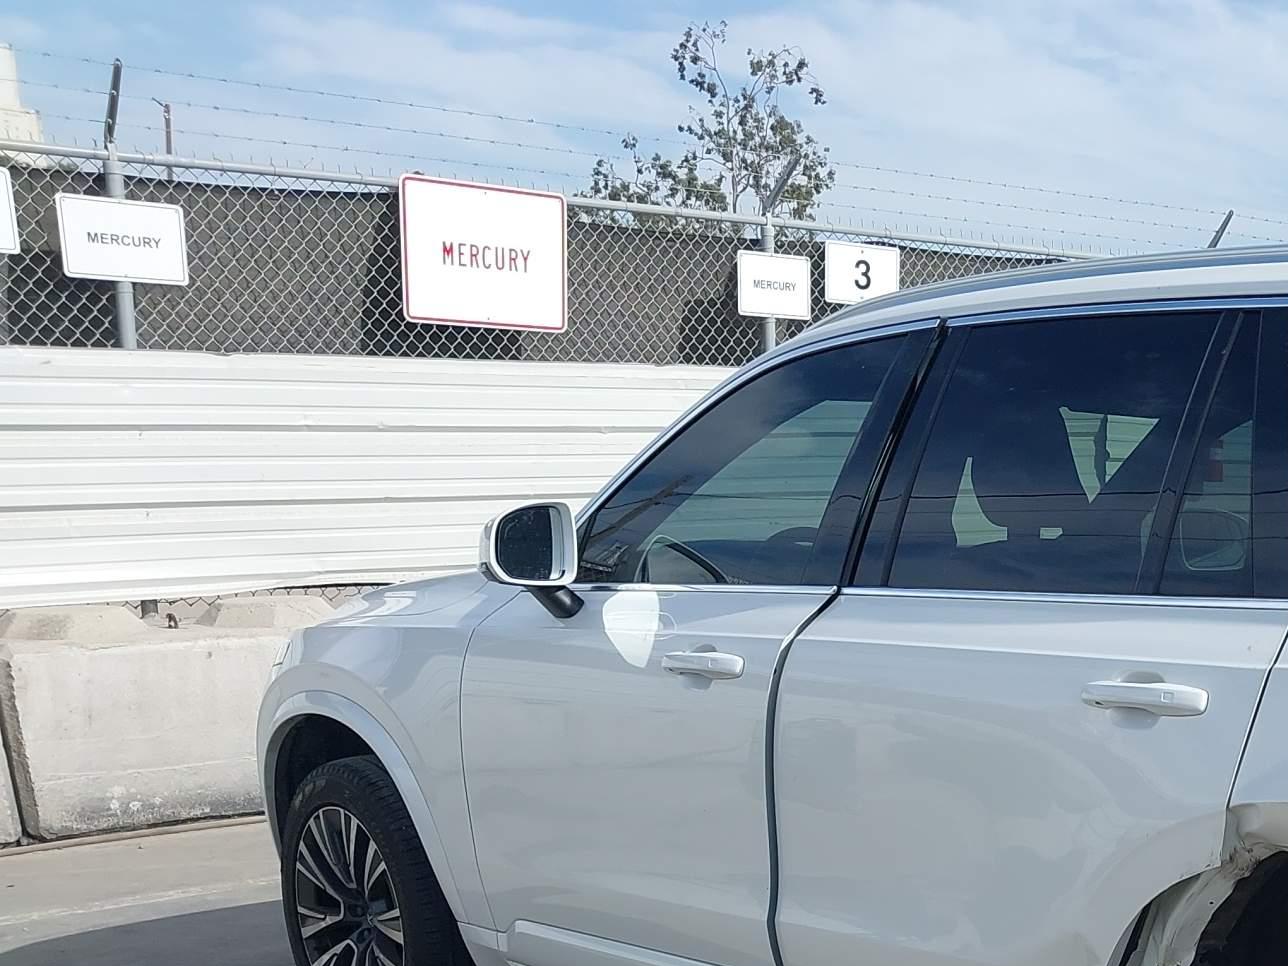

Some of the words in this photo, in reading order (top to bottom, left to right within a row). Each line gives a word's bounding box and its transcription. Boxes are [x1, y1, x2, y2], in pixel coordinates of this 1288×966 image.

[86, 231, 161, 249] MERCURY
[442, 240, 531, 273] MERCURY
[753, 279, 797, 292] MERCURY
[854, 259, 872, 291] 3
